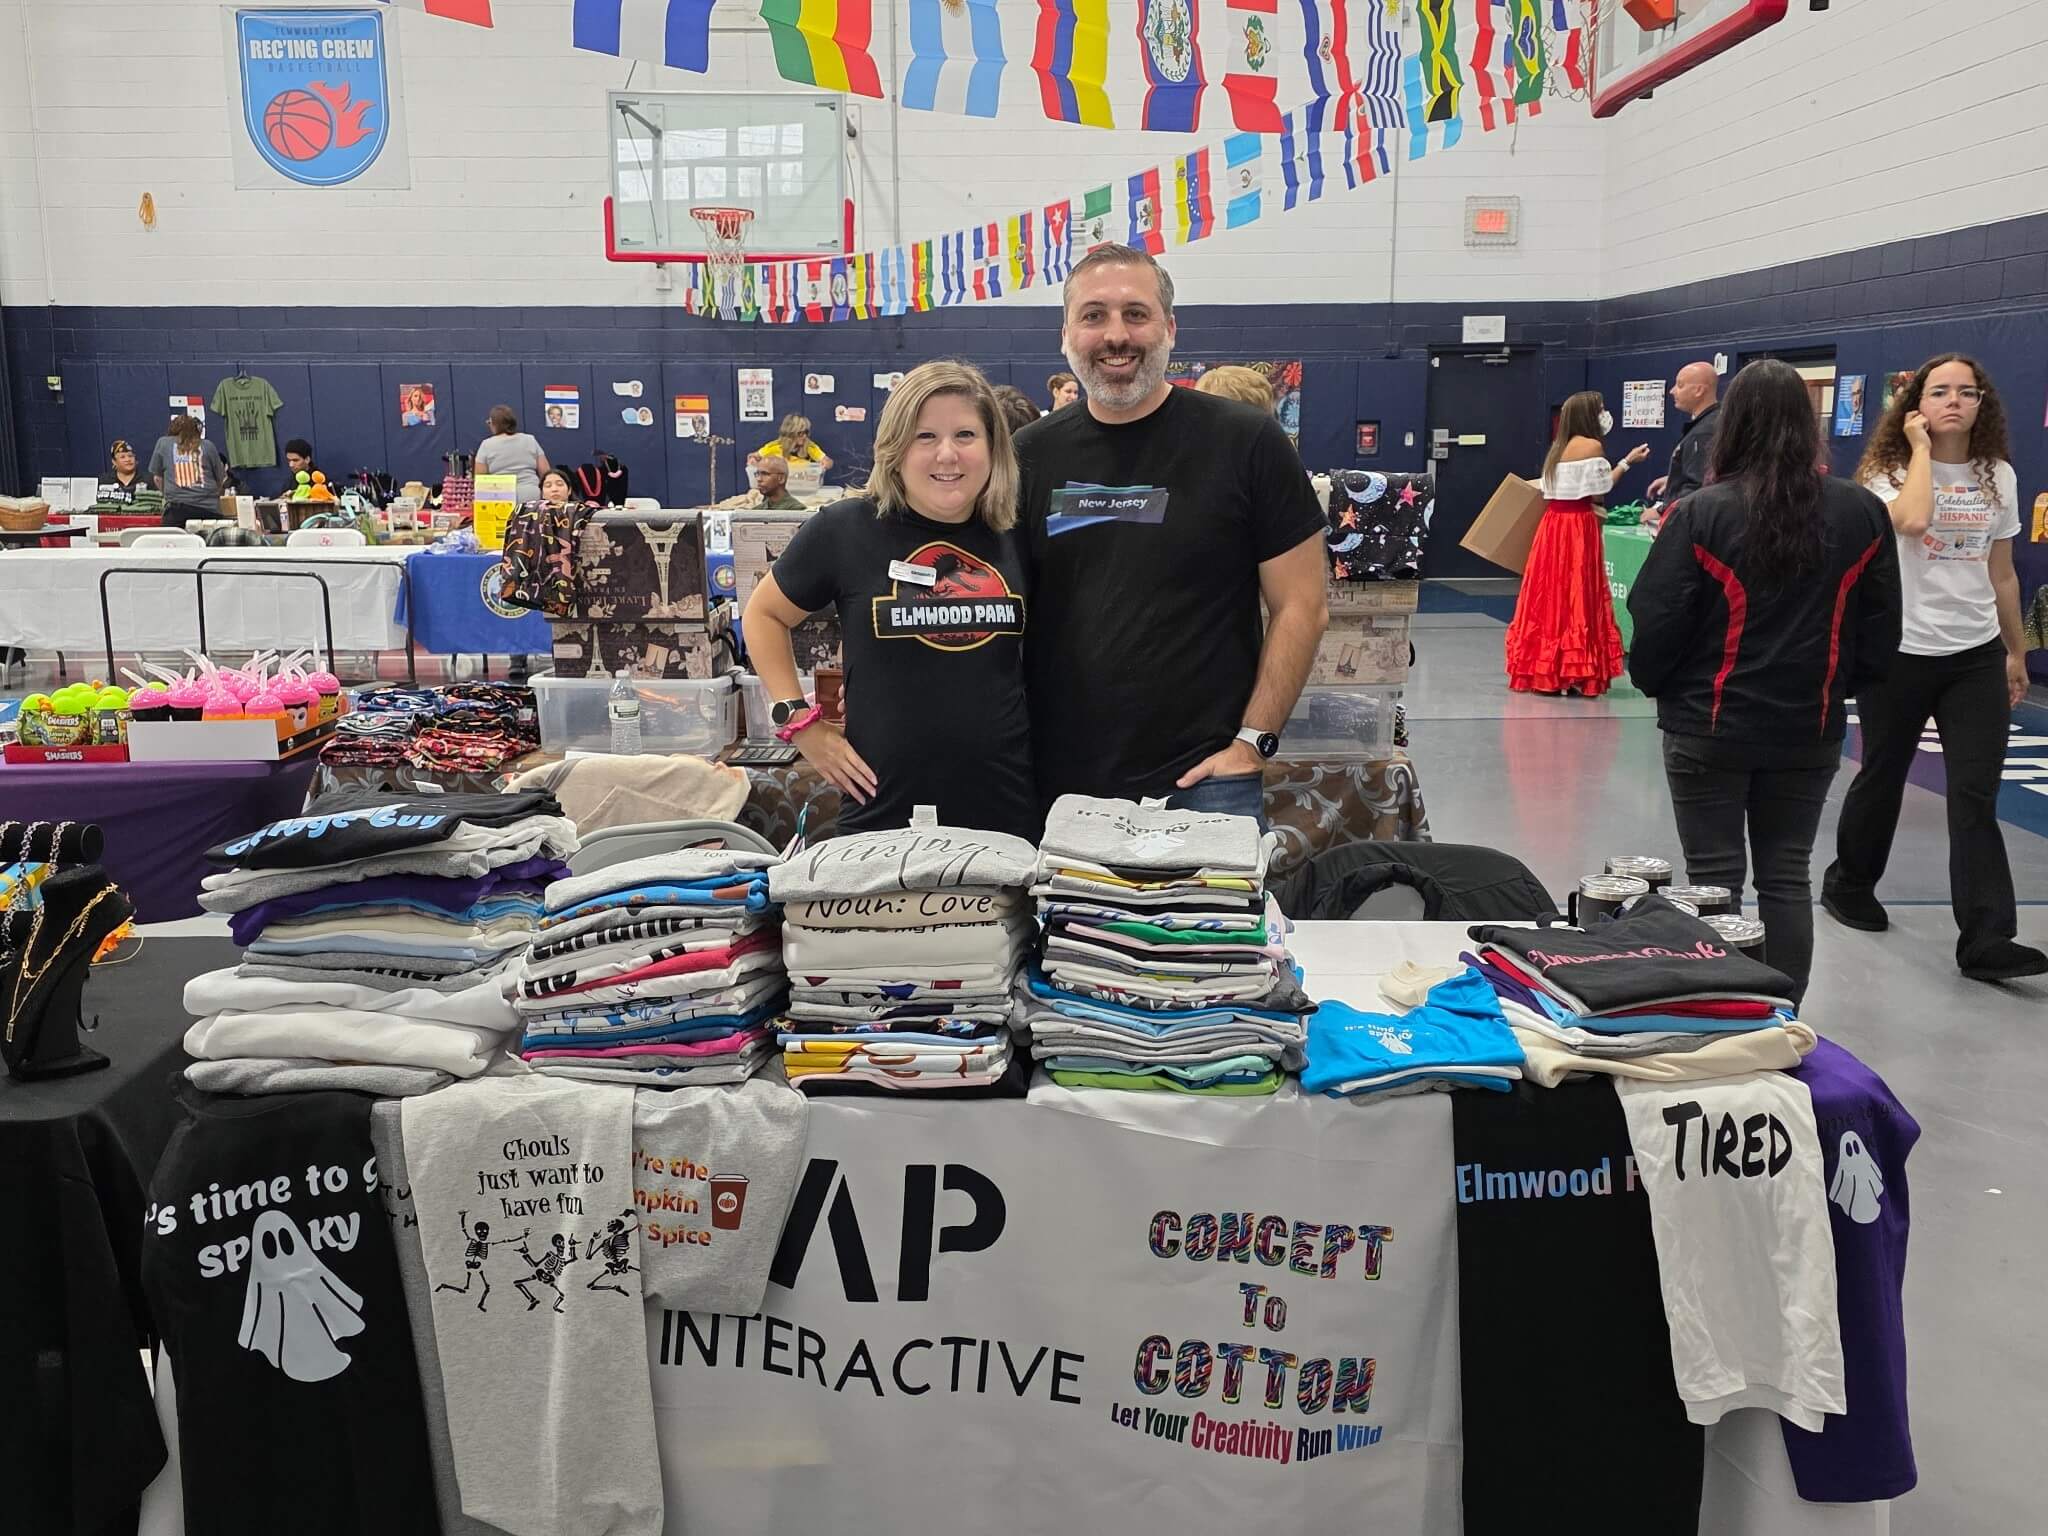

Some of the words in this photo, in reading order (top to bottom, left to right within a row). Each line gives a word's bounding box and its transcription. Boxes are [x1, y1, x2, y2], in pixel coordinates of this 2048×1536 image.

[249, 38, 319, 60] REC'ING
[321, 38, 374, 60] CREW
[267, 61, 362, 73] BASKETBALL
[1078, 498, 1106, 509] New
[1108, 497, 1149, 509] Jersey
[1936, 494, 1993, 507] Celebrating
[1939, 512, 1990, 522] HISPANIC
[890, 605, 973, 627] ELMWOOD
[974, 604, 1016, 624] PARK
[369, 803, 448, 831] Guy
[805, 897, 904, 919] Noun:
[501, 1133, 571, 1162] Ghouls
[1662, 1100, 1794, 1182] TIRED
[476, 1164, 520, 1195] just
[527, 1161, 579, 1188] want
[582, 1162, 605, 1186] to
[670, 1154, 710, 1182] the
[1456, 1157, 1612, 1204] Elmwood
[145, 1201, 178, 1236] 's
[189, 1175, 293, 1225] time
[305, 1164, 349, 1197] to
[500, 1190, 551, 1218] have
[647, 1221, 713, 1249] Spice
[1148, 1207, 1395, 1282] CONCEPT
[658, 1306, 1086, 1406] INTERACTIVE
[1132, 1333, 1377, 1416] COTTON
[1110, 1402, 1139, 1432] Let
[1142, 1407, 1190, 1445] Your
[1191, 1411, 1293, 1466] Creativity
[1296, 1426, 1333, 1463] Run
[1336, 1423, 1383, 1453] Wild
